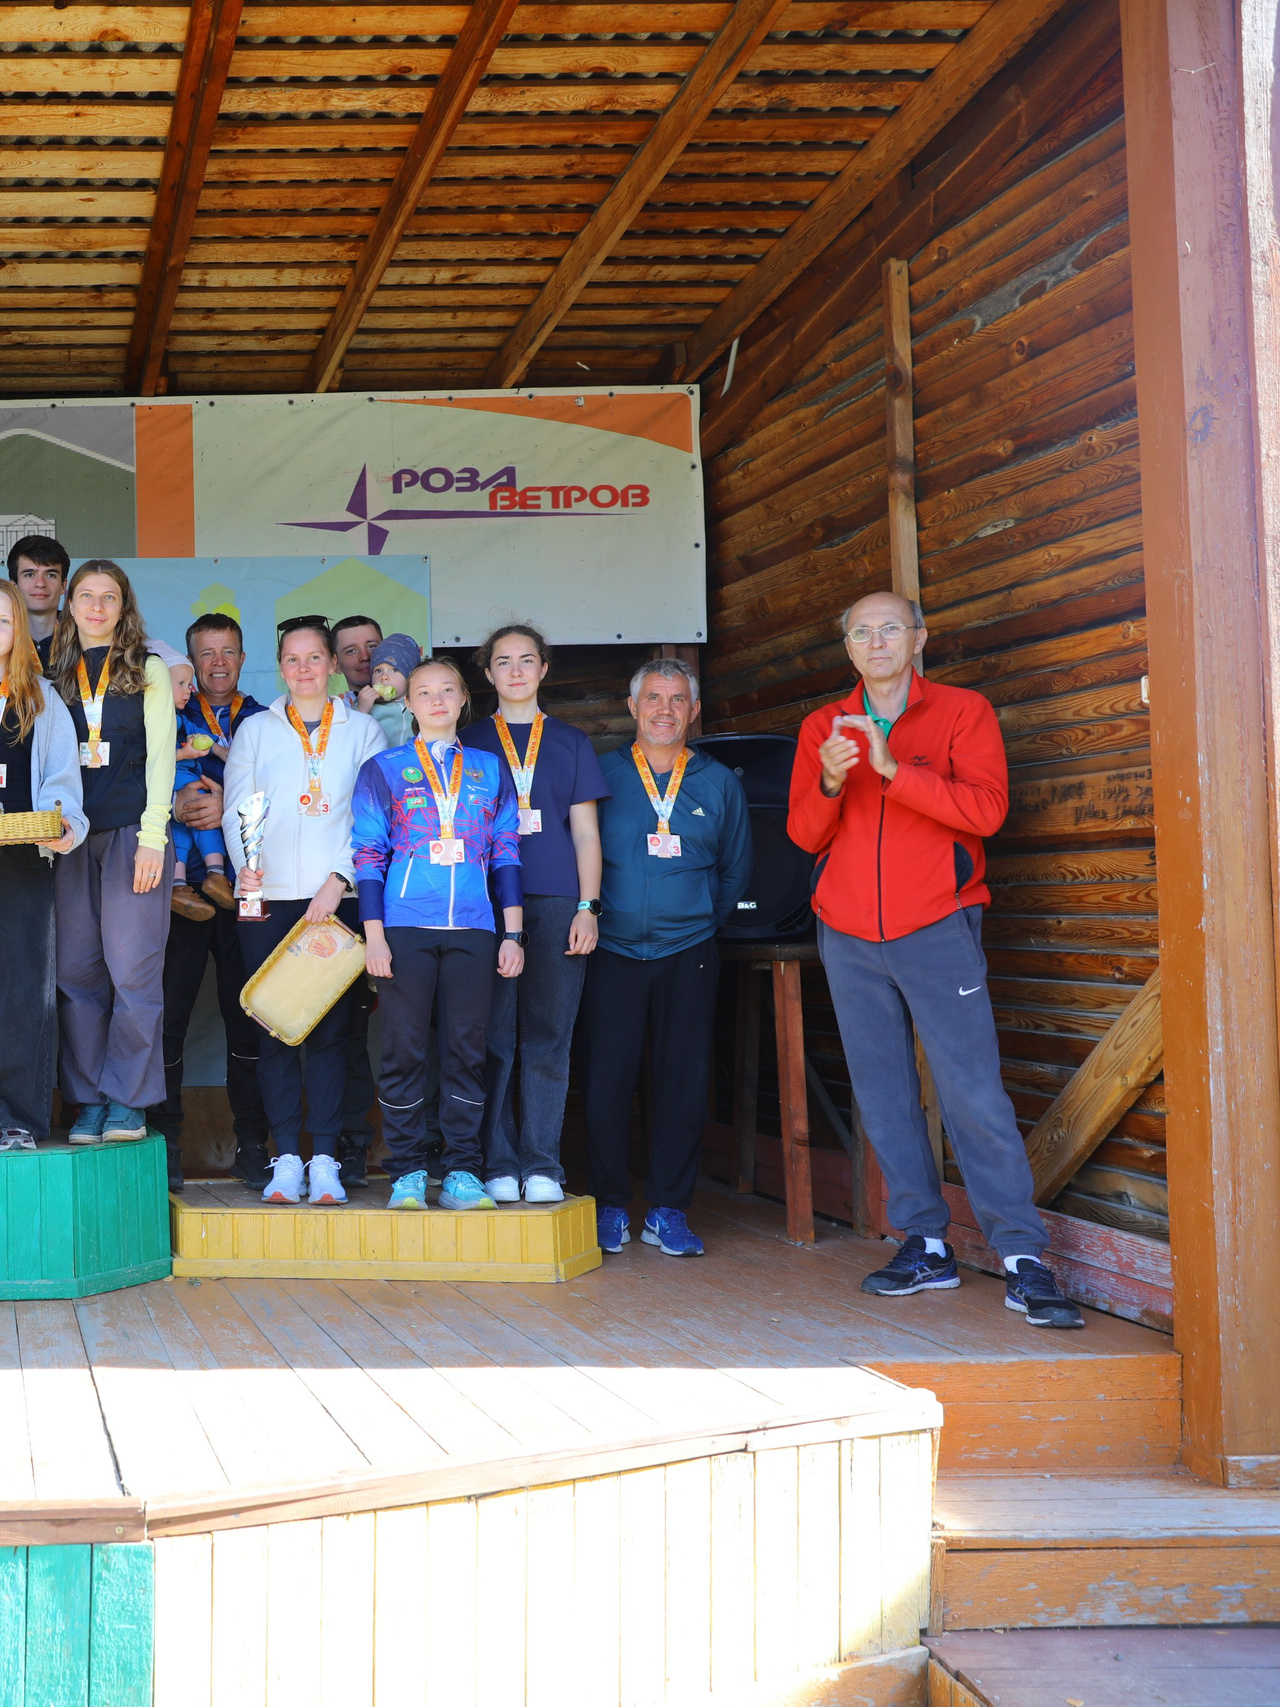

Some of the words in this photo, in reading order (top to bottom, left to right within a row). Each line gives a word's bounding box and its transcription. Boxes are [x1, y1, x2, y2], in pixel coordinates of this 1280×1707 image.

[392, 466, 517, 494] РОЗА
[488, 484, 650, 511] ВЕТРОВ
[0, 775, 4, 785] 1
[321, 804, 329, 813] 3
[533, 821, 540, 831] 3
[672, 846, 680, 854] 3
[456, 851, 464, 861] 3
[255, 908, 261, 916] 3
